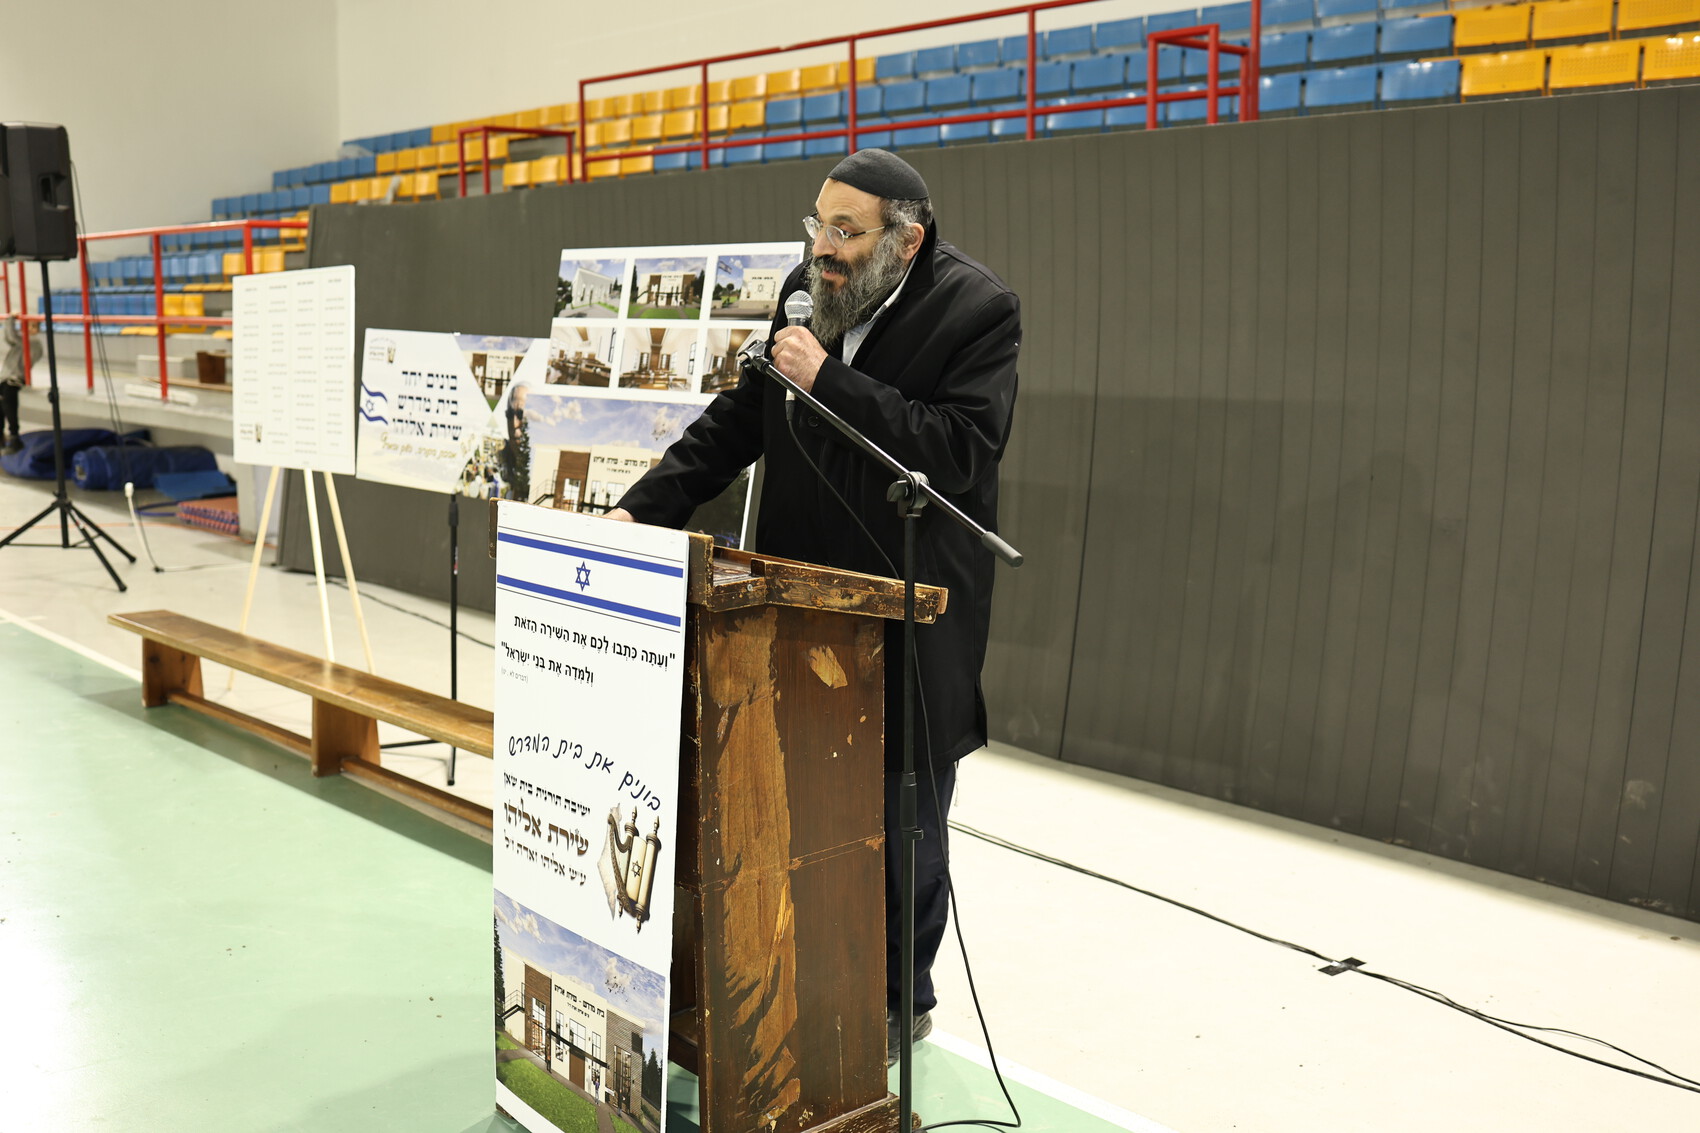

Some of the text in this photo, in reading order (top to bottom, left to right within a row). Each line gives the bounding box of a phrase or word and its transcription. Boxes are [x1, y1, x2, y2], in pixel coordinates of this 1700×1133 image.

[401, 371, 458, 390] בונים יחד
[397, 394, 458, 415] בית מדרש
[392, 411, 462, 441] שירת אליהו
[509, 733, 661, 811] בונים את בית המדרש
[503, 771, 591, 816] ישיבה תורנית בית שאן
[503, 796, 589, 857] שירת אליהו
[540, 852, 566, 876] אליהו
